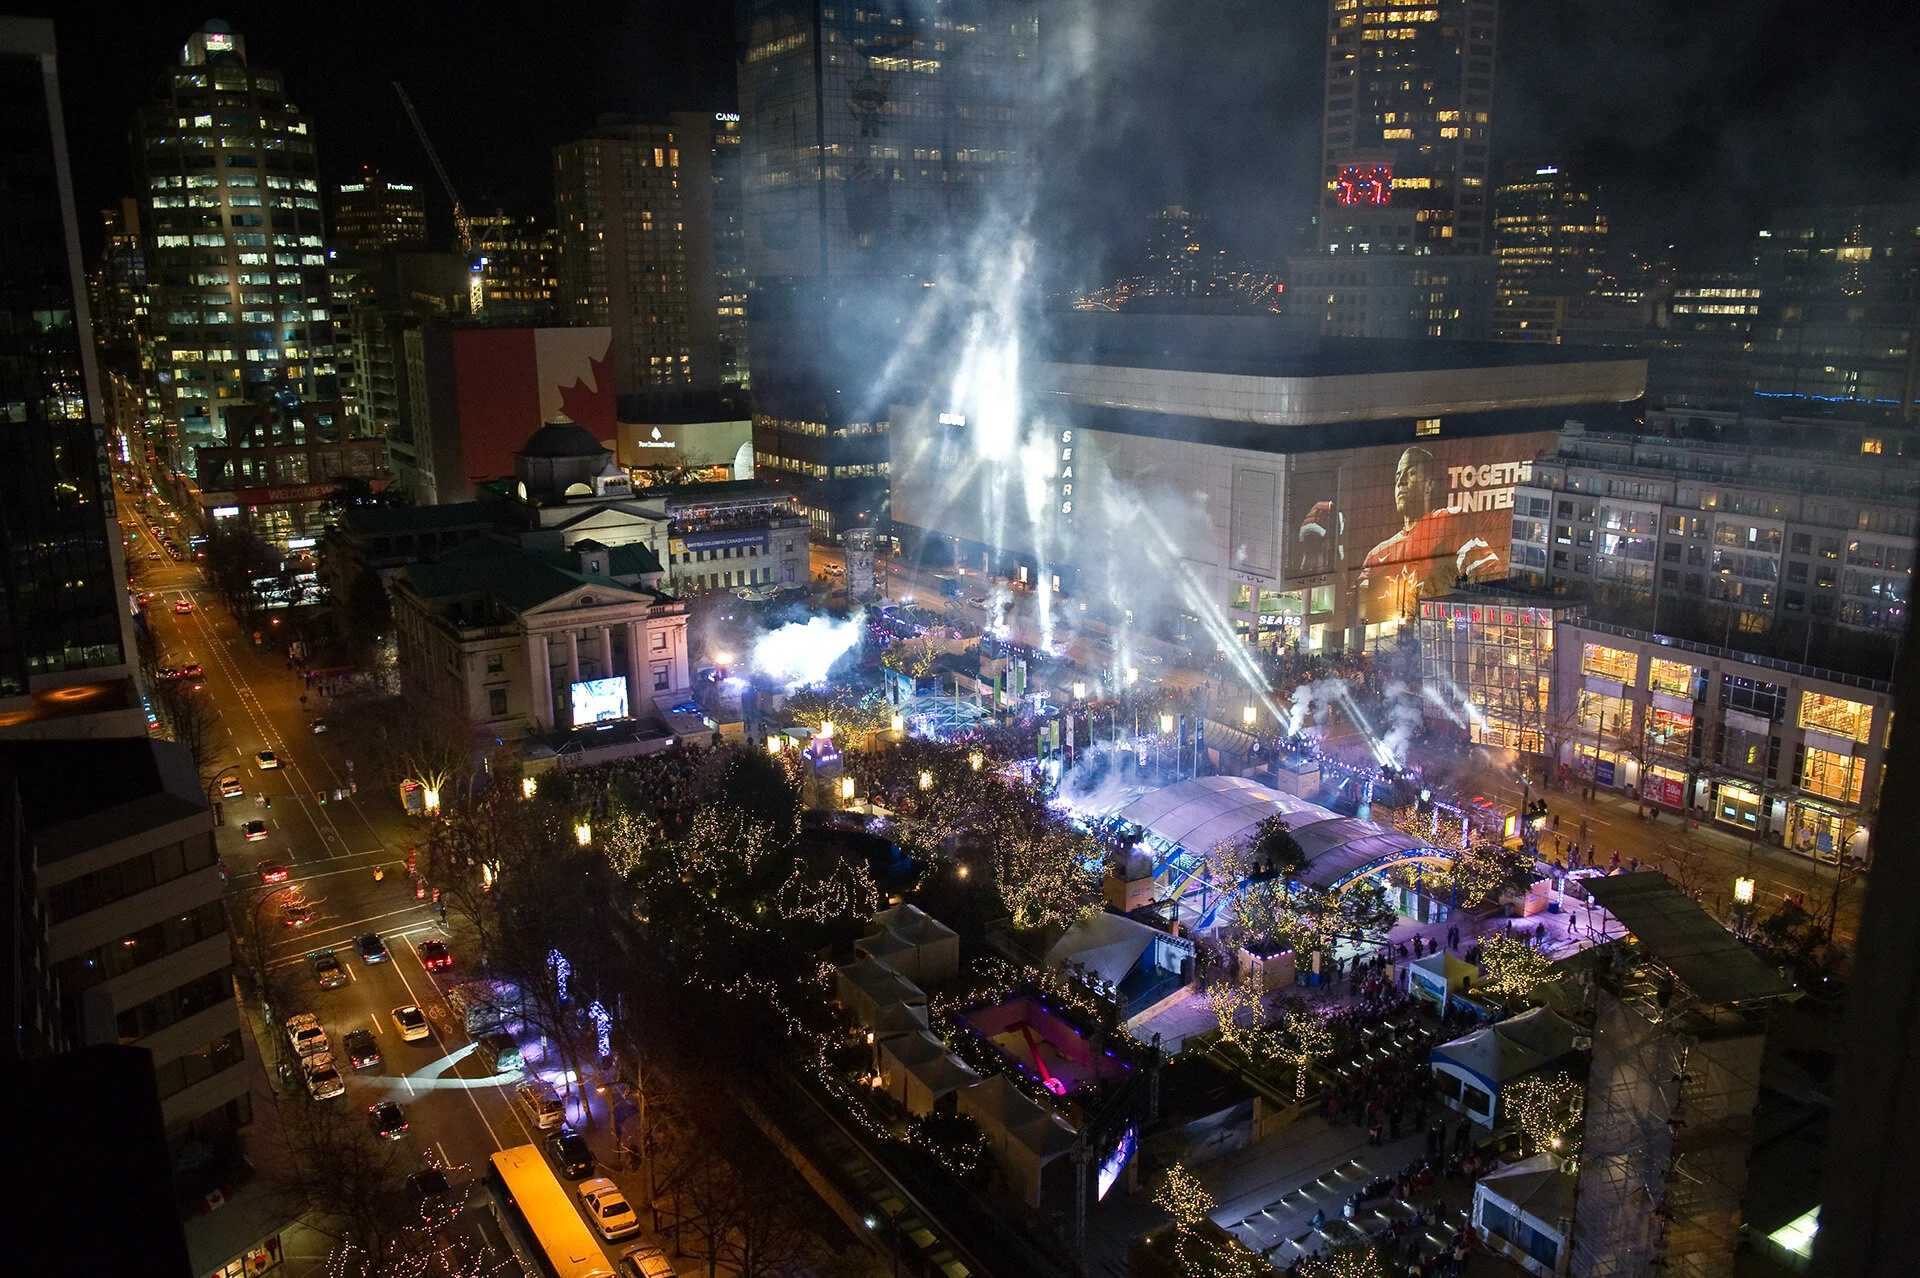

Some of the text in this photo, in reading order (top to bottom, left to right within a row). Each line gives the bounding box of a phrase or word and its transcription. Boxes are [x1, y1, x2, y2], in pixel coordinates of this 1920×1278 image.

[1061, 430, 1073, 514] SEARS
[1448, 460, 1533, 489] TOGETH
[268, 485, 321, 501] WELCOME
[1259, 615, 1302, 626] SEARS
[1423, 602, 1548, 626] Chapters
